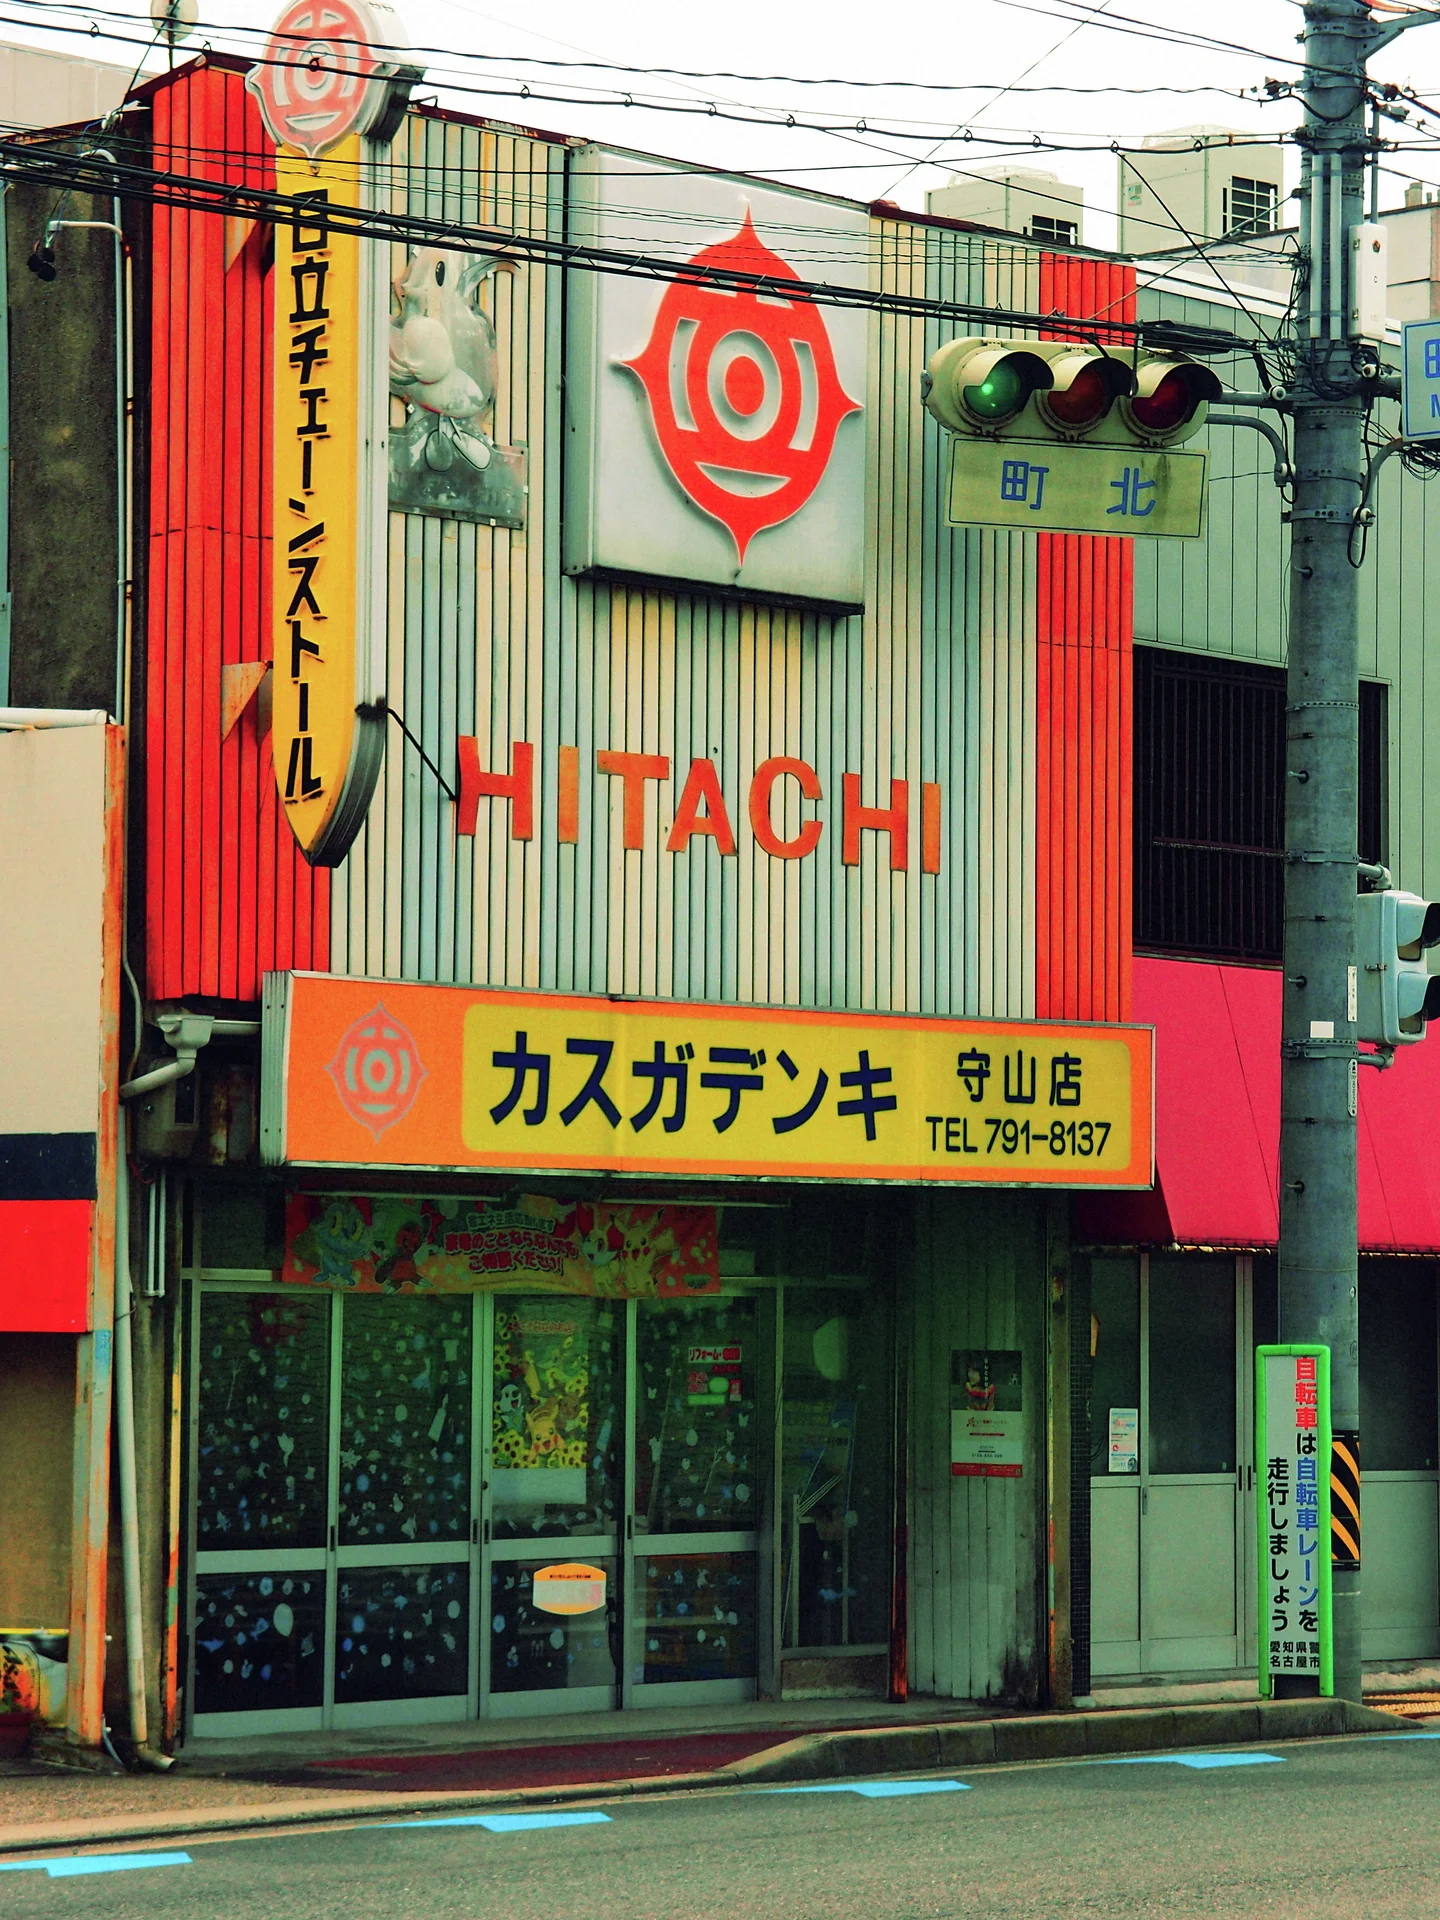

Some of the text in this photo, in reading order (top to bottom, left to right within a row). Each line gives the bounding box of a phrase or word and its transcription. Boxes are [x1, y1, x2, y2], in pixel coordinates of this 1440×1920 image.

[457, 735, 942, 875] HITACHI
[489, 1030, 898, 1142] カスガデンキ
[957, 1047, 1082, 1107] 守山店
[925, 1116, 1112, 1157] TEL 791-8137
[1295, 1356, 1318, 1633] 自転車は自転車レーンを
[1267, 1457, 1291, 1632] 走行しましょう
[1269, 1641, 1320, 1654] 愛知県警
[1269, 1655, 1320, 1669] 名古屋市
